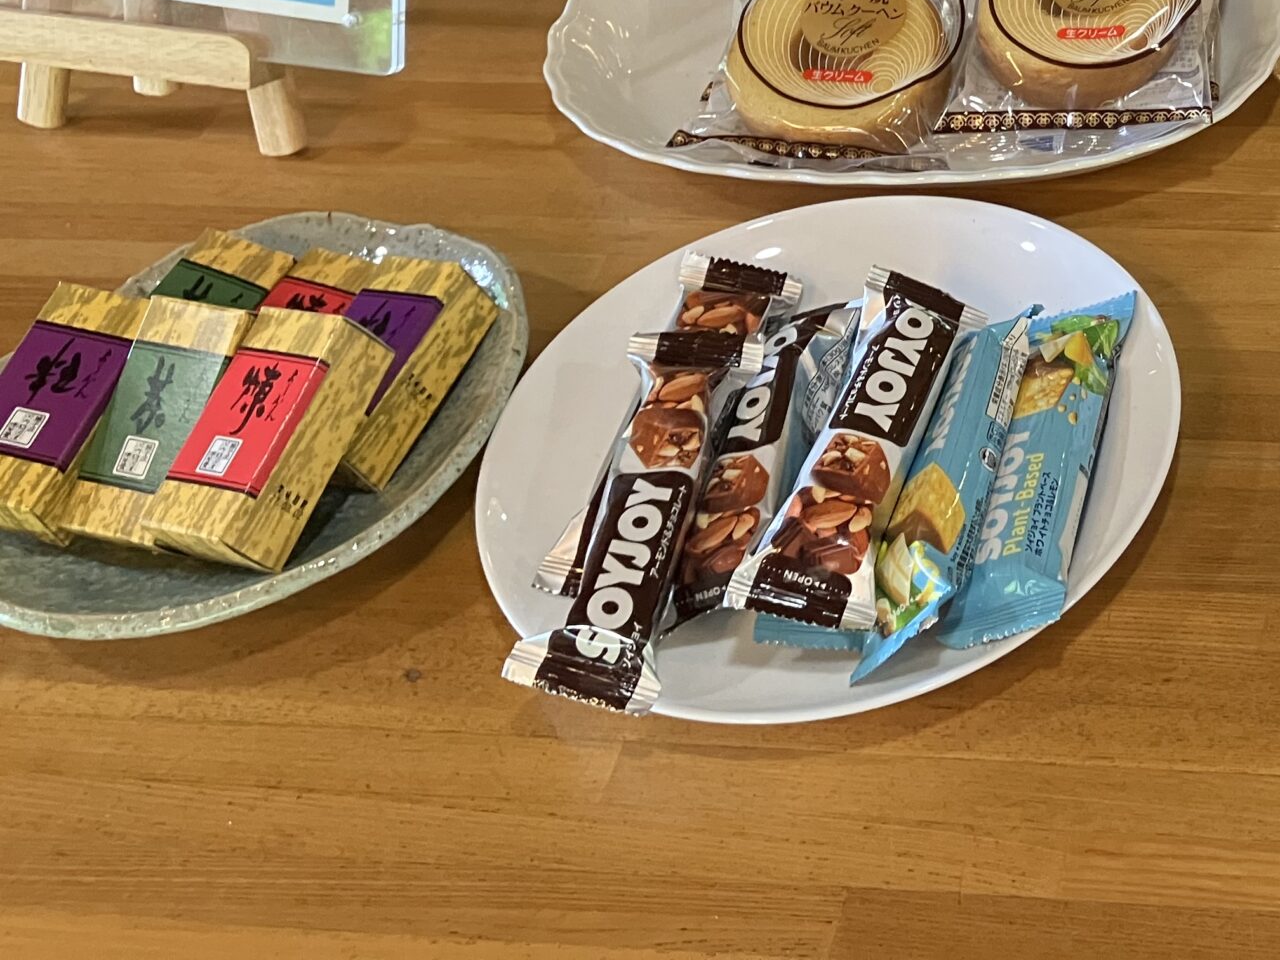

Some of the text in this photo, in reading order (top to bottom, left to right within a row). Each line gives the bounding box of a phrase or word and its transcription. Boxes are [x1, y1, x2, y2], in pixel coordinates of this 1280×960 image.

[803, 1, 905, 20] バウムクーヘン
[1065, 28, 1118, 39] 生クリーム
[811, 70, 865, 82] 生クリーム
[854, 297, 935, 433] OYJOY
[1002, 452, 1045, 558] Plant-Based
[575, 477, 674, 665] SOYJOY
[783, 568, 814, 588] OPEN
